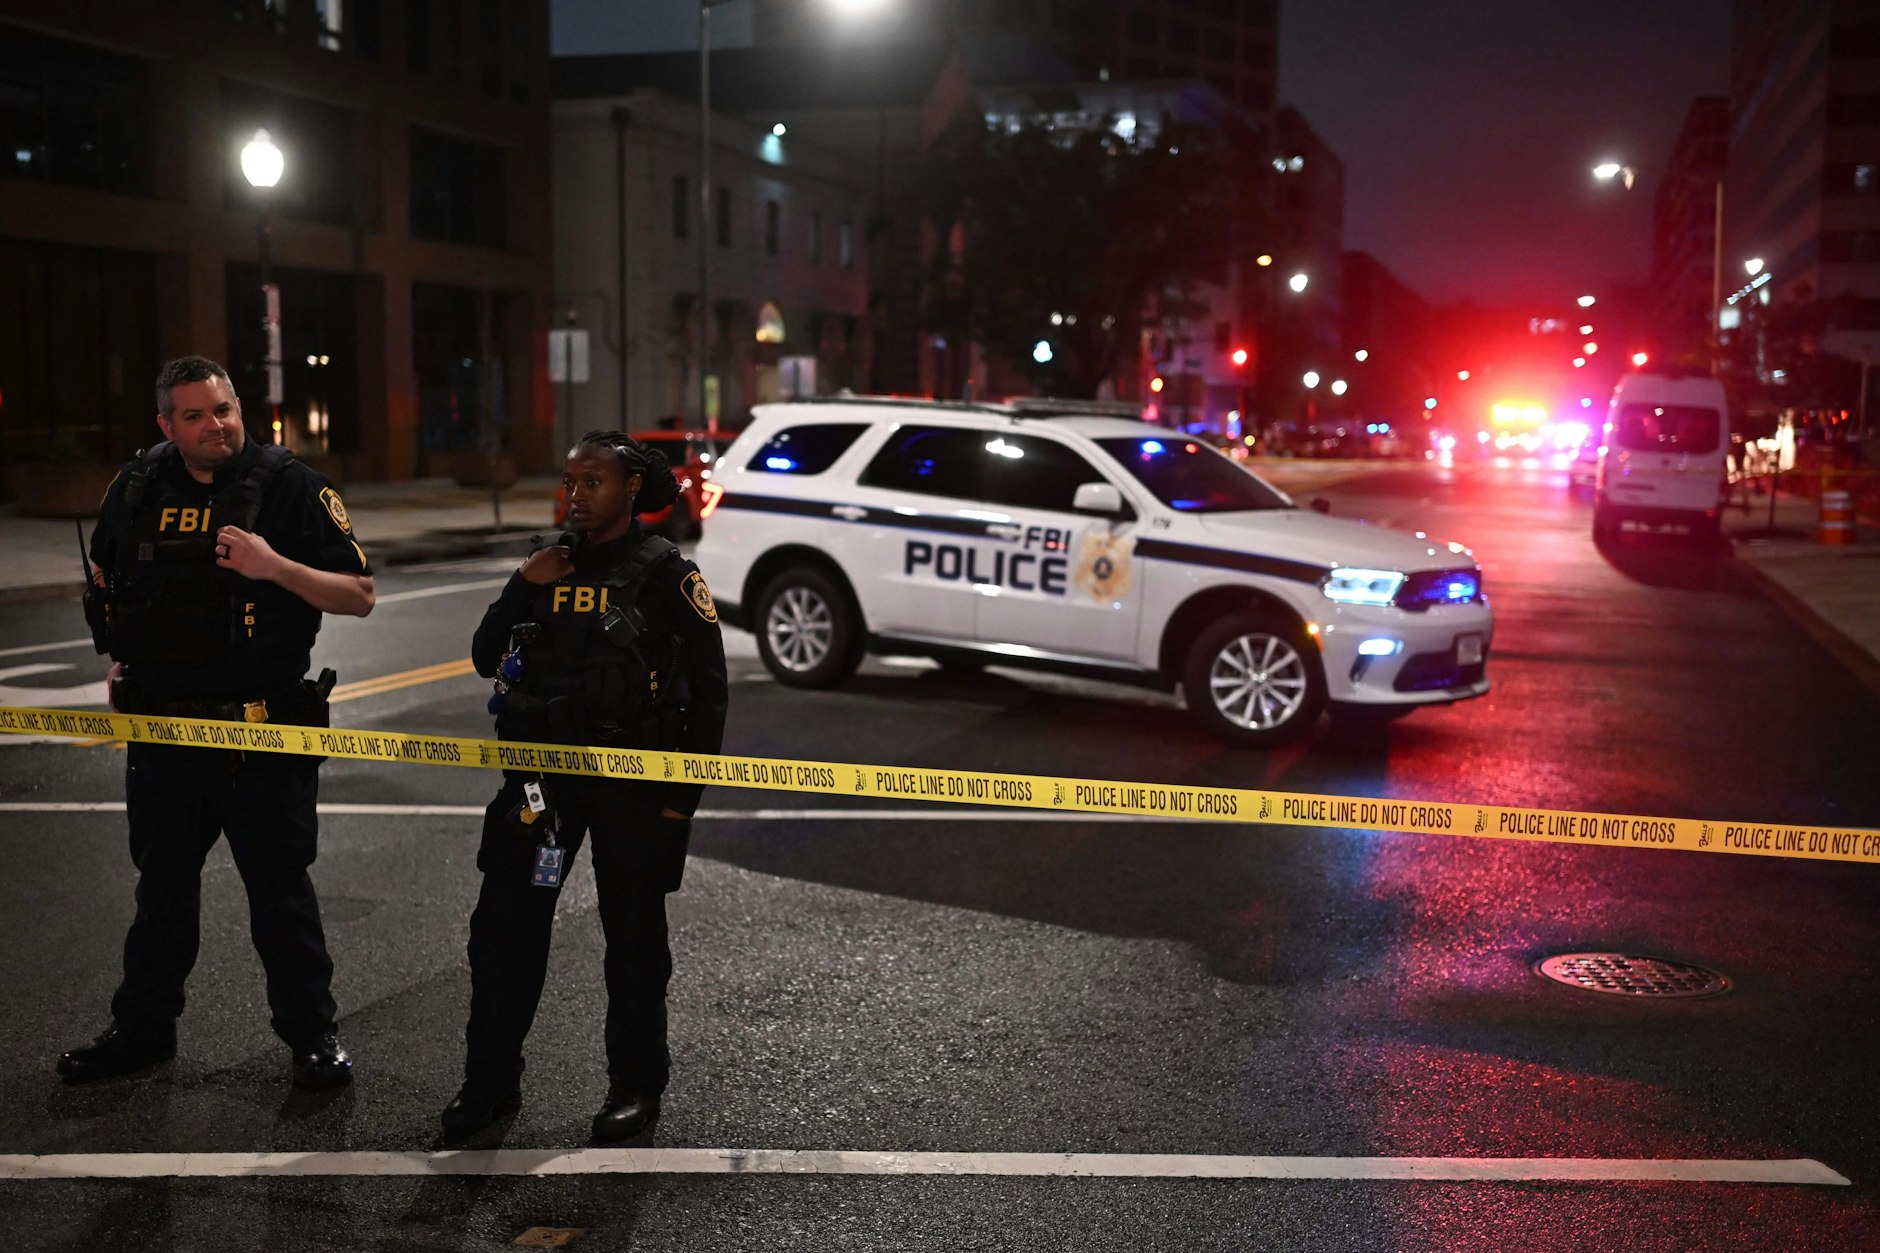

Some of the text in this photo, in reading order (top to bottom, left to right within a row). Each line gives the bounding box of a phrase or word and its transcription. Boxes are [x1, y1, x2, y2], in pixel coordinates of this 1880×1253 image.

[159, 507, 211, 532] FBI
[1023, 526, 1072, 554] FBI
[904, 540, 1067, 595] POLICE
[553, 586, 608, 613] FBI
[244, 602, 255, 638] FBI
[0, 711, 18, 729] ICE
[16, 712, 42, 731] LINE
[40, 714, 57, 732] DO
[57, 715, 78, 733] NOT
[78, 716, 114, 736] CROSS
[147, 722, 184, 740] POLICE
[184, 724, 207, 742] LINE
[208, 726, 224, 744] DO
[226, 728, 248, 746] NOT
[250, 729, 284, 748] CROSS
[320, 734, 358, 754] POLICE
[358, 736, 382, 755] LINE
[384, 738, 400, 757] DO
[400, 740, 422, 758] NOT
[424, 742, 460, 762] CROSS
[498, 747, 536, 766] POLICE
[537, 750, 562, 768] LINE
[564, 751, 580, 770] DO
[582, 752, 604, 772] NOT
[606, 754, 644, 774] CROSS
[684, 760, 722, 780] POLICE
[724, 762, 750, 782] LINE
[752, 764, 768, 784] DO
[771, 765, 793, 785] NOT
[796, 766, 835, 788] CROSS
[876, 772, 916, 793] POLICE
[919, 775, 944, 795] LINE
[948, 777, 963, 797] DO
[967, 778, 989, 798] NOT
[993, 780, 1032, 801] CROSS
[1076, 785, 1116, 806] POLICE
[1120, 788, 1146, 808] LINE
[1150, 790, 1166, 810] DO
[1170, 792, 1193, 812] NOT
[1197, 793, 1237, 815] CROSS
[1284, 799, 1326, 820] POLICE
[1330, 802, 1357, 822] LINE
[1361, 804, 1377, 824] DO
[1382, 805, 1406, 826] NOT
[1410, 806, 1452, 828] CROSS
[1500, 812, 1544, 835] POLICE
[1548, 816, 1576, 837] LINE
[1580, 818, 1598, 838] DO
[1602, 819, 1628, 840] NOT
[1631, 821, 1676, 843] CROSS
[1725, 827, 1772, 849] POLICE
[1775, 830, 1806, 851] LINE
[1809, 832, 1828, 853] DO
[1832, 833, 1861, 855] NOT
